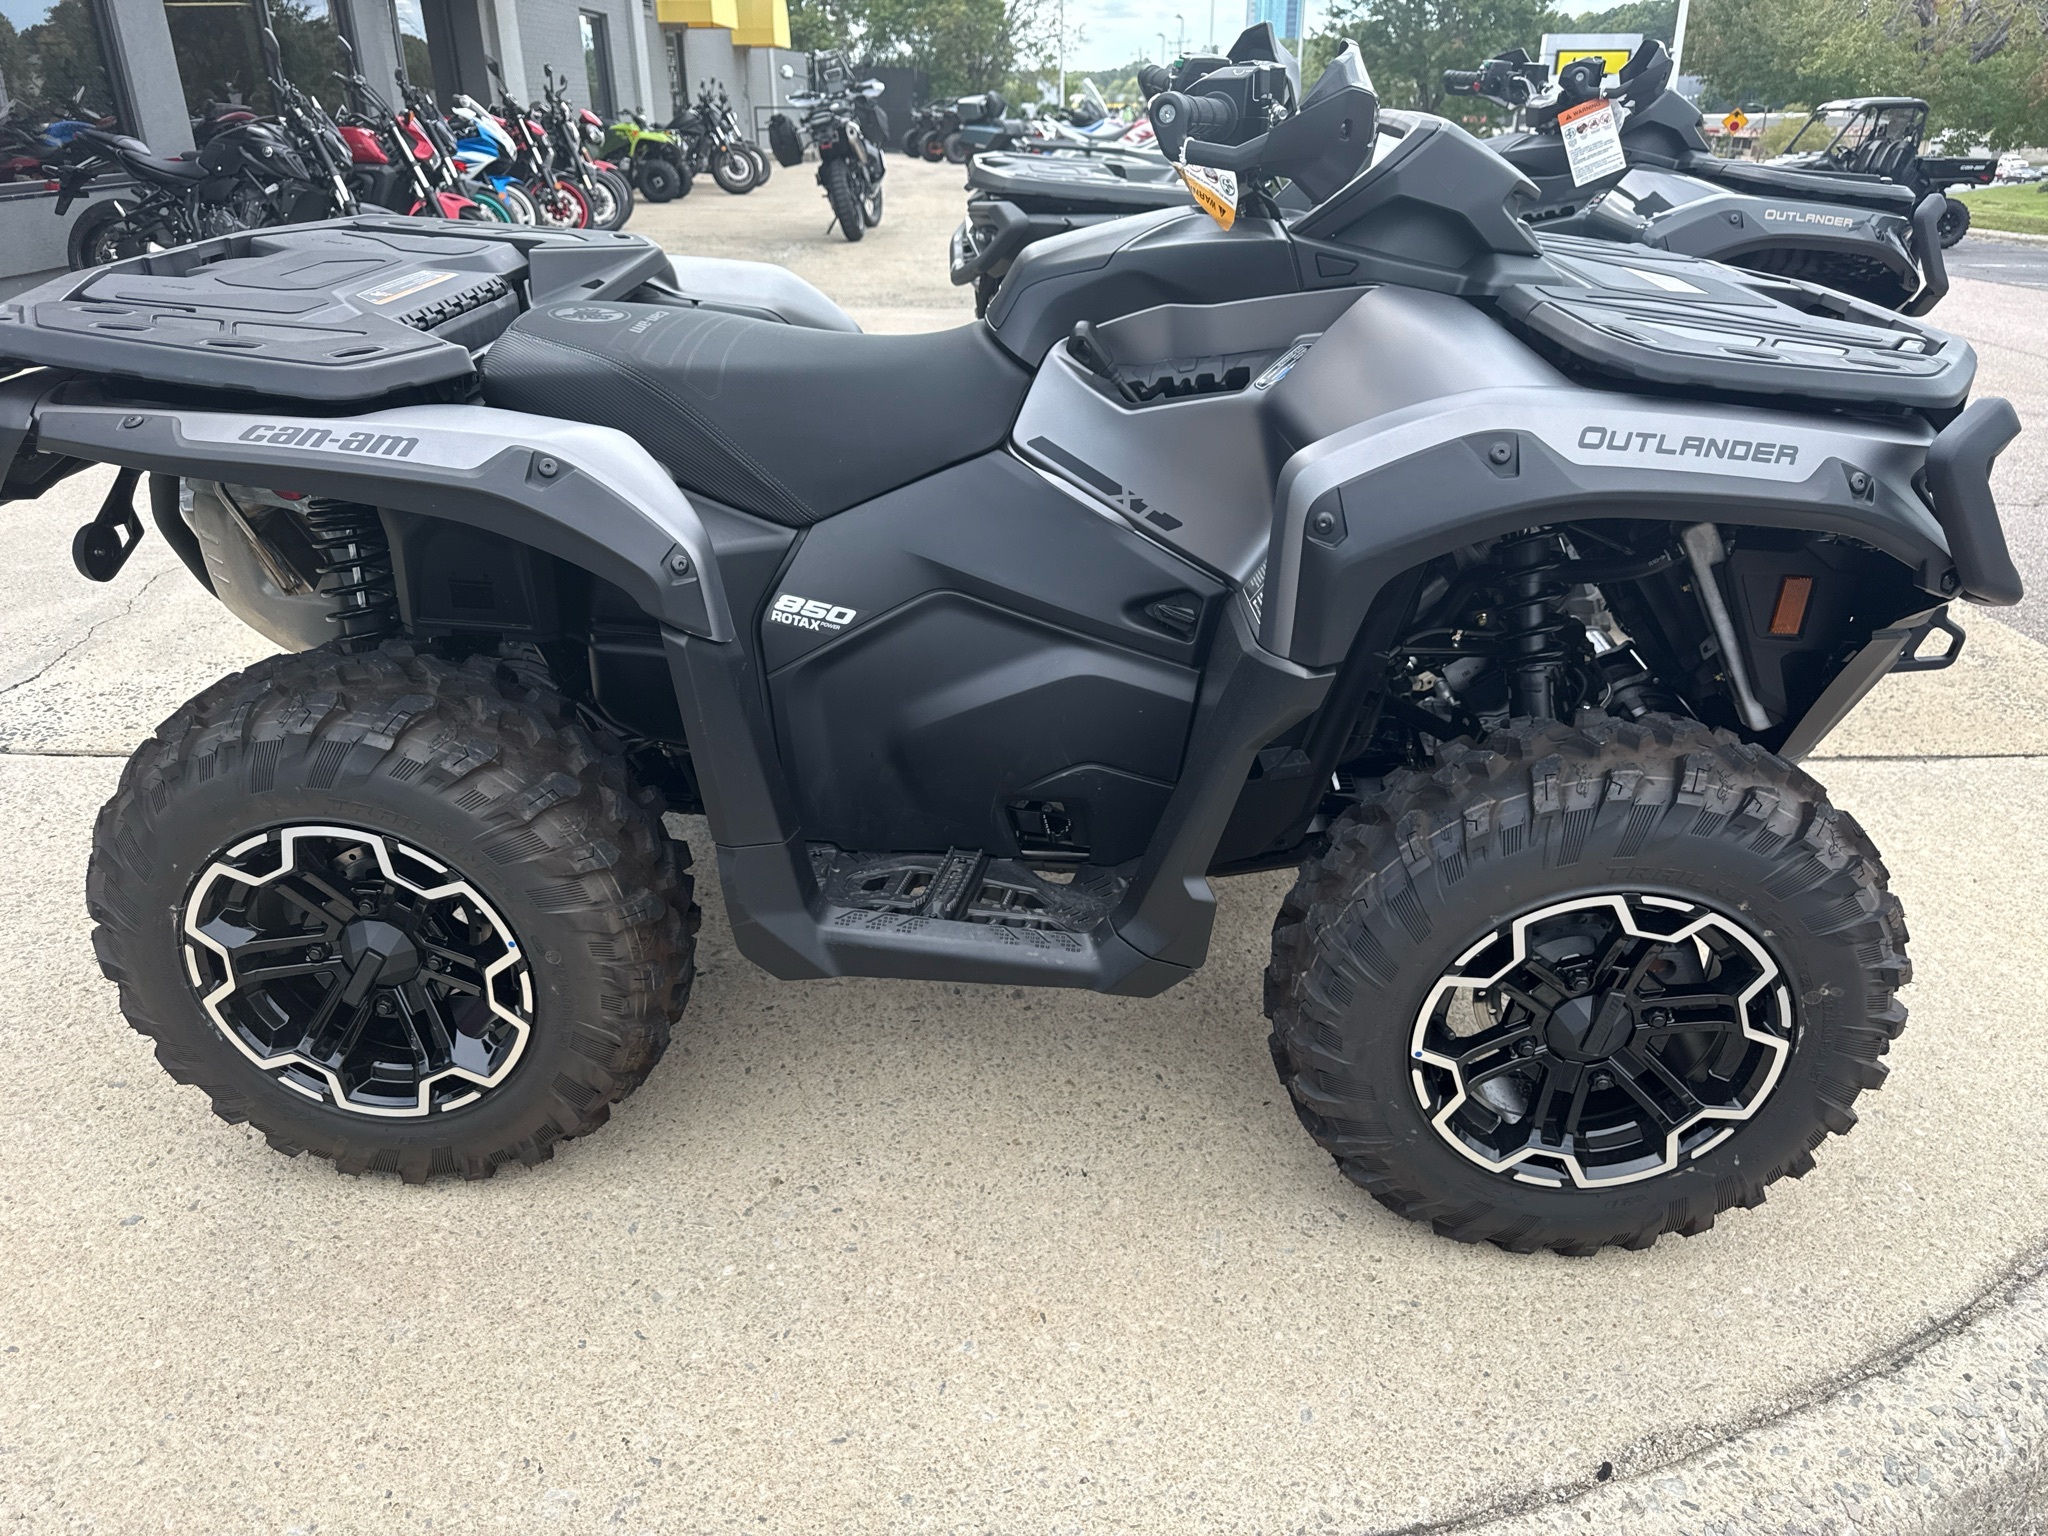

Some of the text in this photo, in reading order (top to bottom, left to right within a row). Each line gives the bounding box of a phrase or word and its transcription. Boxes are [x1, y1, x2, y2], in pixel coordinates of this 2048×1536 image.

[1572, 101, 1602, 117] WARNING
[1764, 208, 1854, 228] OUTLANDER
[628, 310, 671, 334] can-am
[238, 424, 420, 457] can-am
[1577, 426, 1799, 466] OUTLANDER
[771, 609, 841, 631] ROTAX POWER
[774, 594, 857, 625] 850
